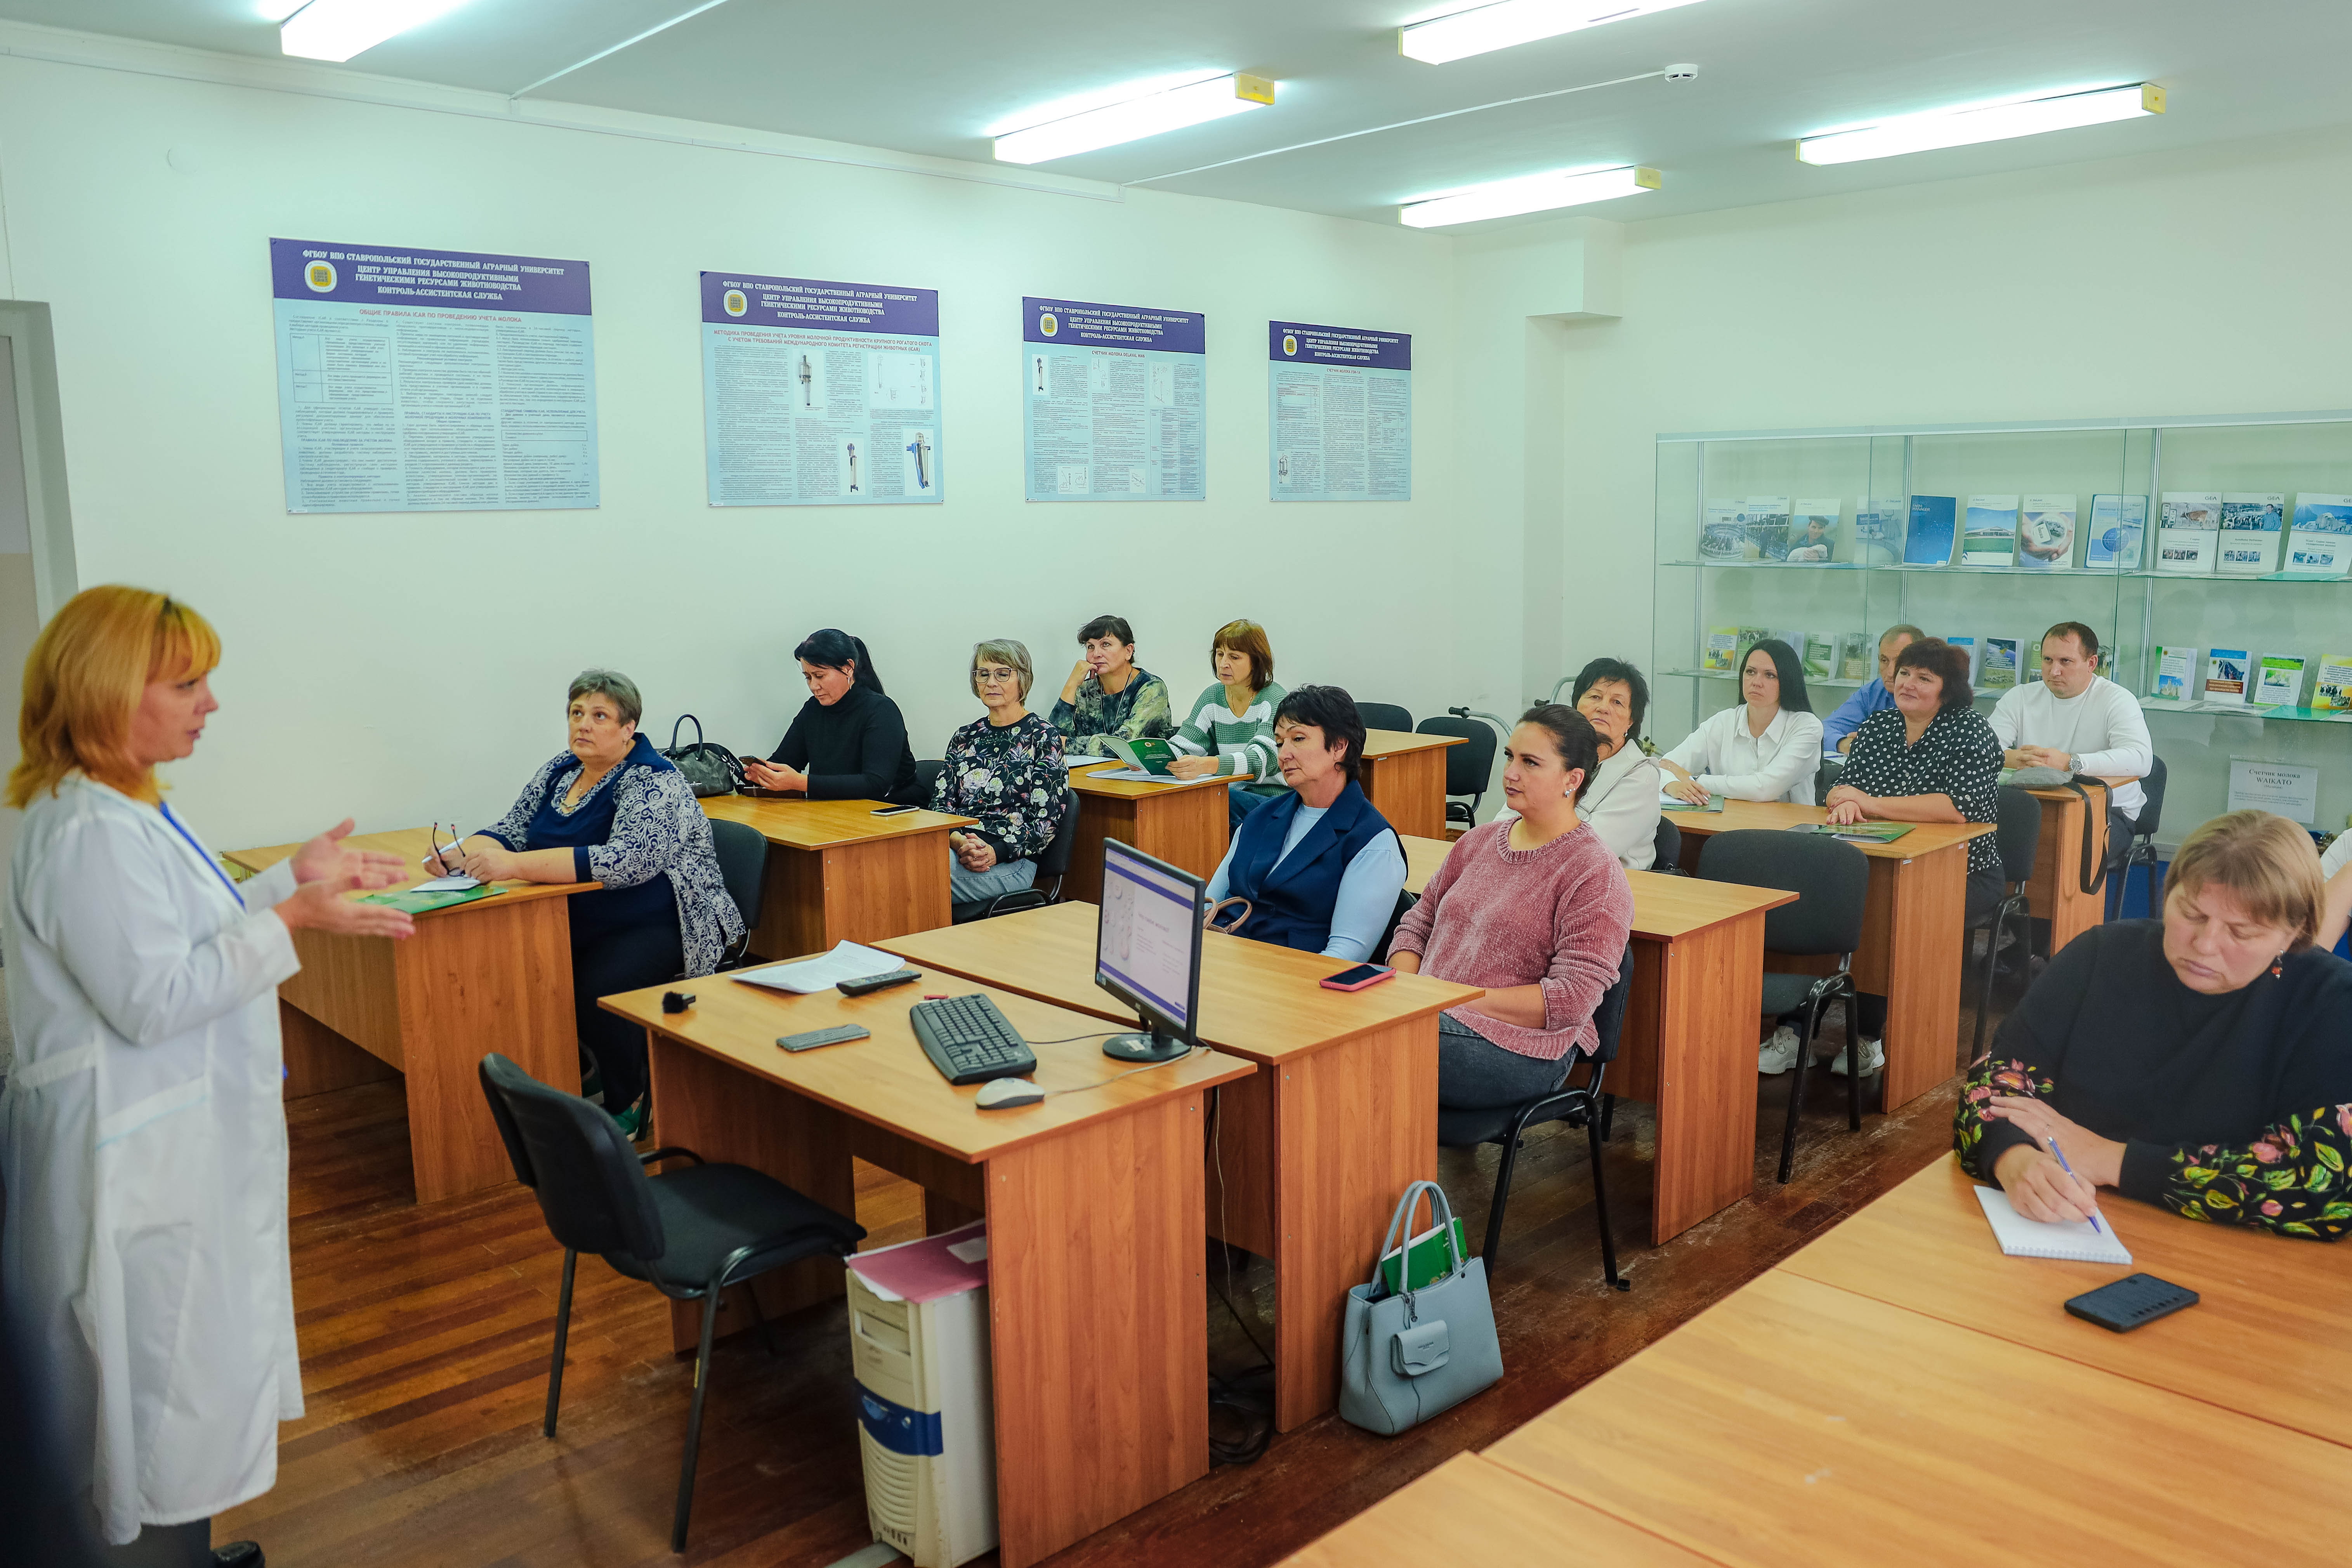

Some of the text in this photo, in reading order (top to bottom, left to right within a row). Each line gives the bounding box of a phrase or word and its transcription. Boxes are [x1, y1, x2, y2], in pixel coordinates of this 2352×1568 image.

[346, 254, 411, 264] СТАВРОПОЛЬСКИЙ
[413, 258, 480, 268] ГОСУДАРСТВЕННЫЙ
[520, 266, 564, 274] УНИВЕРСИТЕТ
[383, 267, 430, 276] УПРАВЛЕНИЯ
[432, 271, 519, 281] ВЫСОКОПРОДУКТИВНЫМИ
[355, 274, 521, 290] ГЕНЕТИЧЕСКИМИ РЕСУРСАМИ ЖИВОТНОВОДСТВА
[377, 287, 472, 297] КОНТРОЛЬ-АССИСТЕНТСКАЯ
[755, 283, 803, 292] СТАВРОПОЛЬСКИЙ
[804, 287, 854, 296] ГОСУДАРСТВЕННЫЙ
[760, 301, 805, 309] ГЕНЕТИЧЕСКИМИ
[838, 306, 885, 314] ЖИВОТНОВОДСТВА
[818, 298, 883, 307] ВЫСОКОПРОДУКТИВНЫМИ
[777, 312, 847, 321] КОНТРОЛЬ-АССИСТЕНТСКАЯ
[1112, 320, 1162, 328] ВЫСОКОПРОДУКТИВНЫМИ
[1080, 332, 1134, 340] КОНТРОЛЬ-АССИСТЕНТСКАЯ
[2257, 777, 2292, 785] WAIKATO
